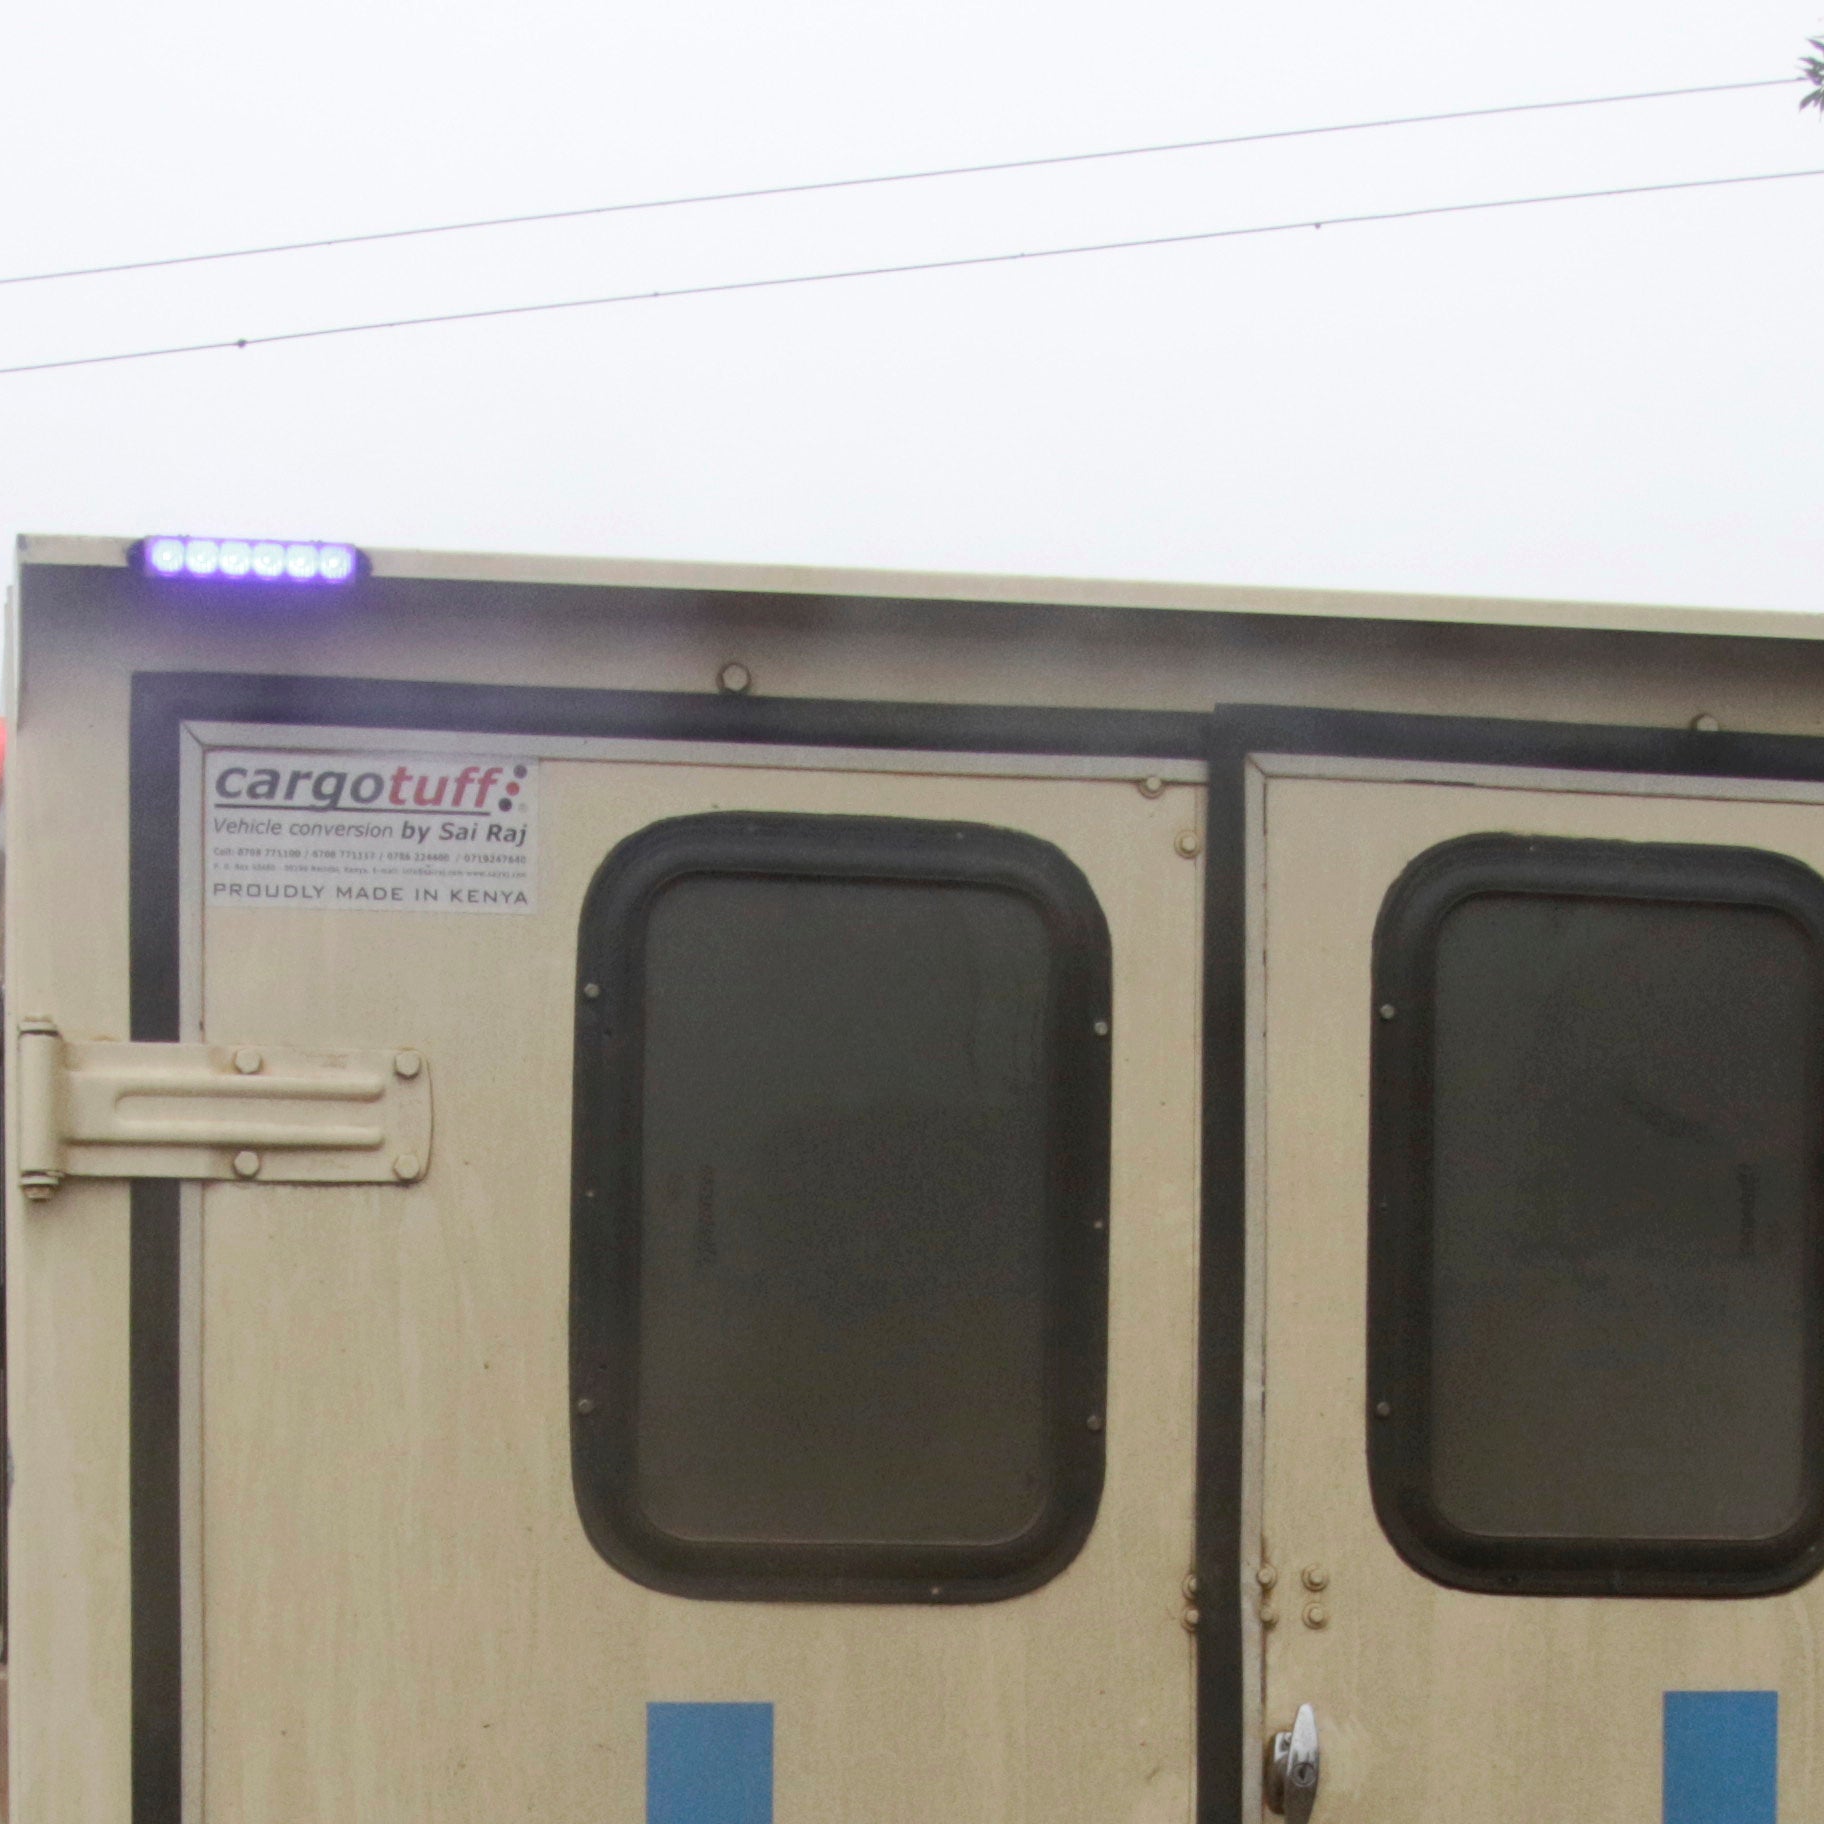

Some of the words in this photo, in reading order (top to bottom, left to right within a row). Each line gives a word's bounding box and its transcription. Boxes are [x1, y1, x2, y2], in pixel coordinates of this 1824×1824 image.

[214, 765, 504, 810] cargotuff
[213, 817, 282, 837] Vehicle
[289, 821, 393, 839] conversion
[401, 820, 429, 843] by
[438, 822, 477, 842] Sai
[486, 823, 529, 846] Raj
[213, 882, 325, 899] PROUDLY
[336, 885, 404, 901] MADE
[415, 888, 439, 902] IN
[450, 888, 528, 904] KENYA
